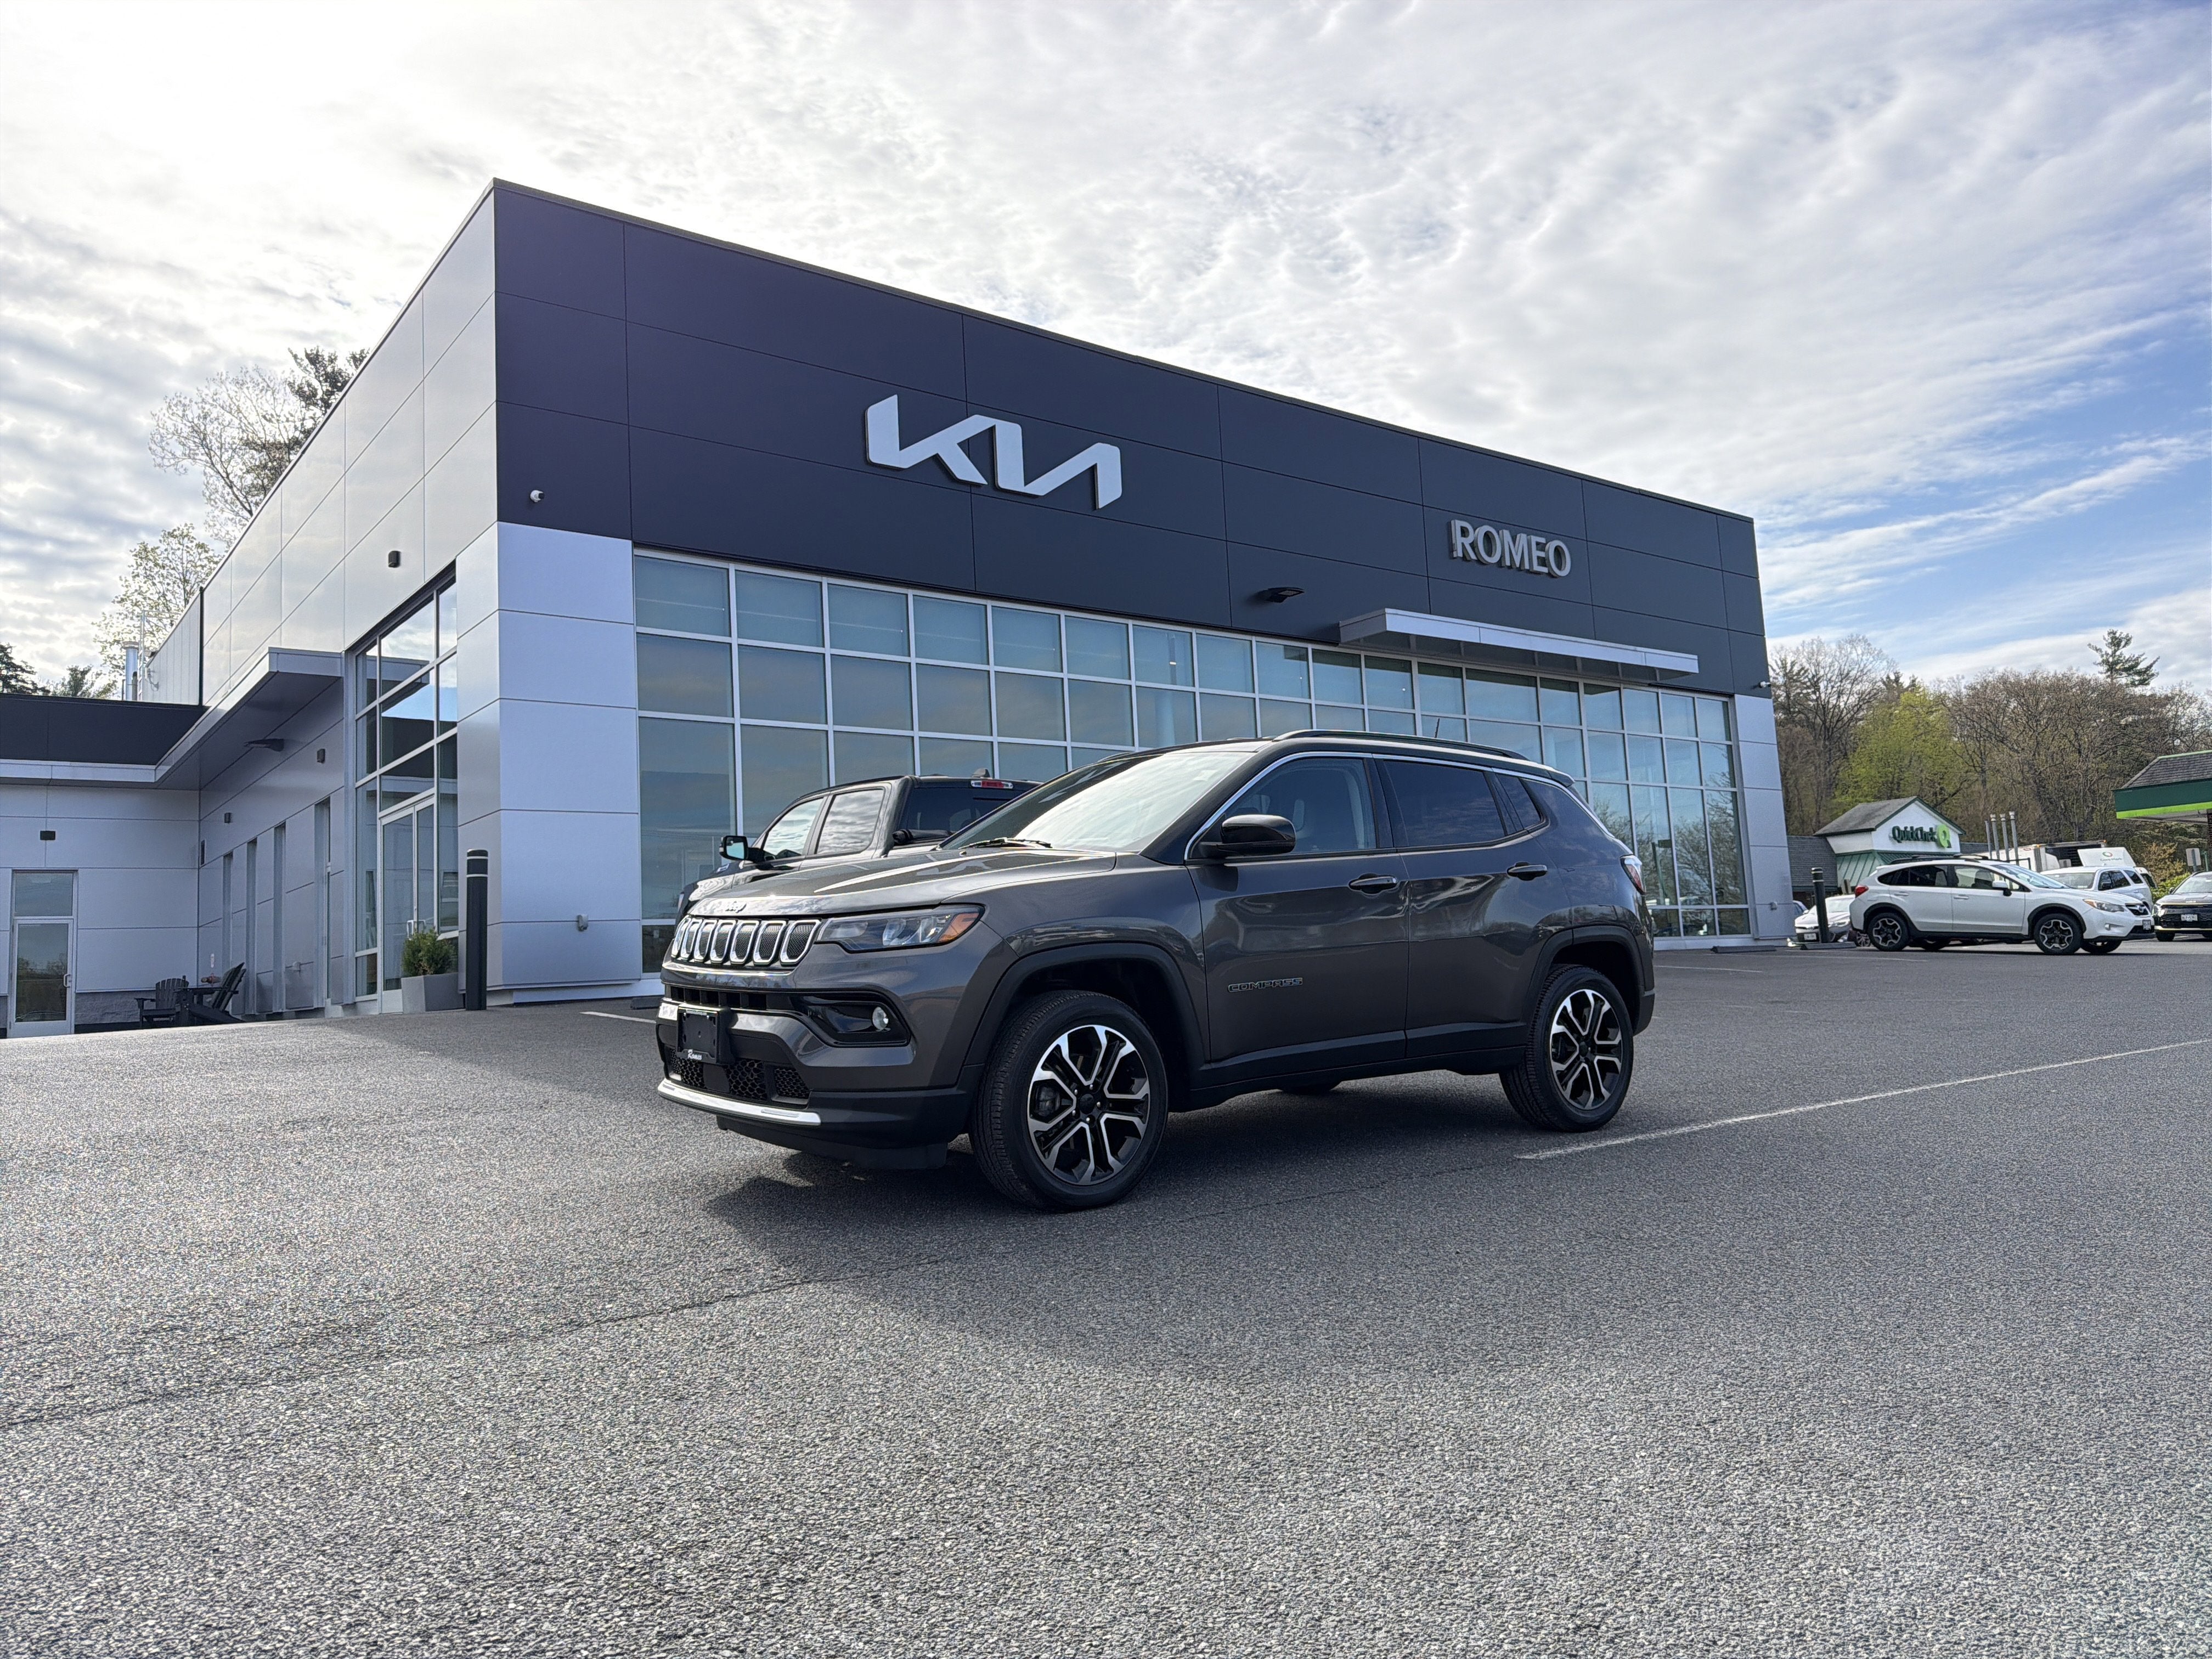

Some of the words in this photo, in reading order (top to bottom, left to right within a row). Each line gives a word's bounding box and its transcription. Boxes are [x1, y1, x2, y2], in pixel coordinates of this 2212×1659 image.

[865, 394, 1122, 509] KIA
[1451, 519, 1571, 577] ROMEO
[1228, 977, 1303, 992] COMPASS
